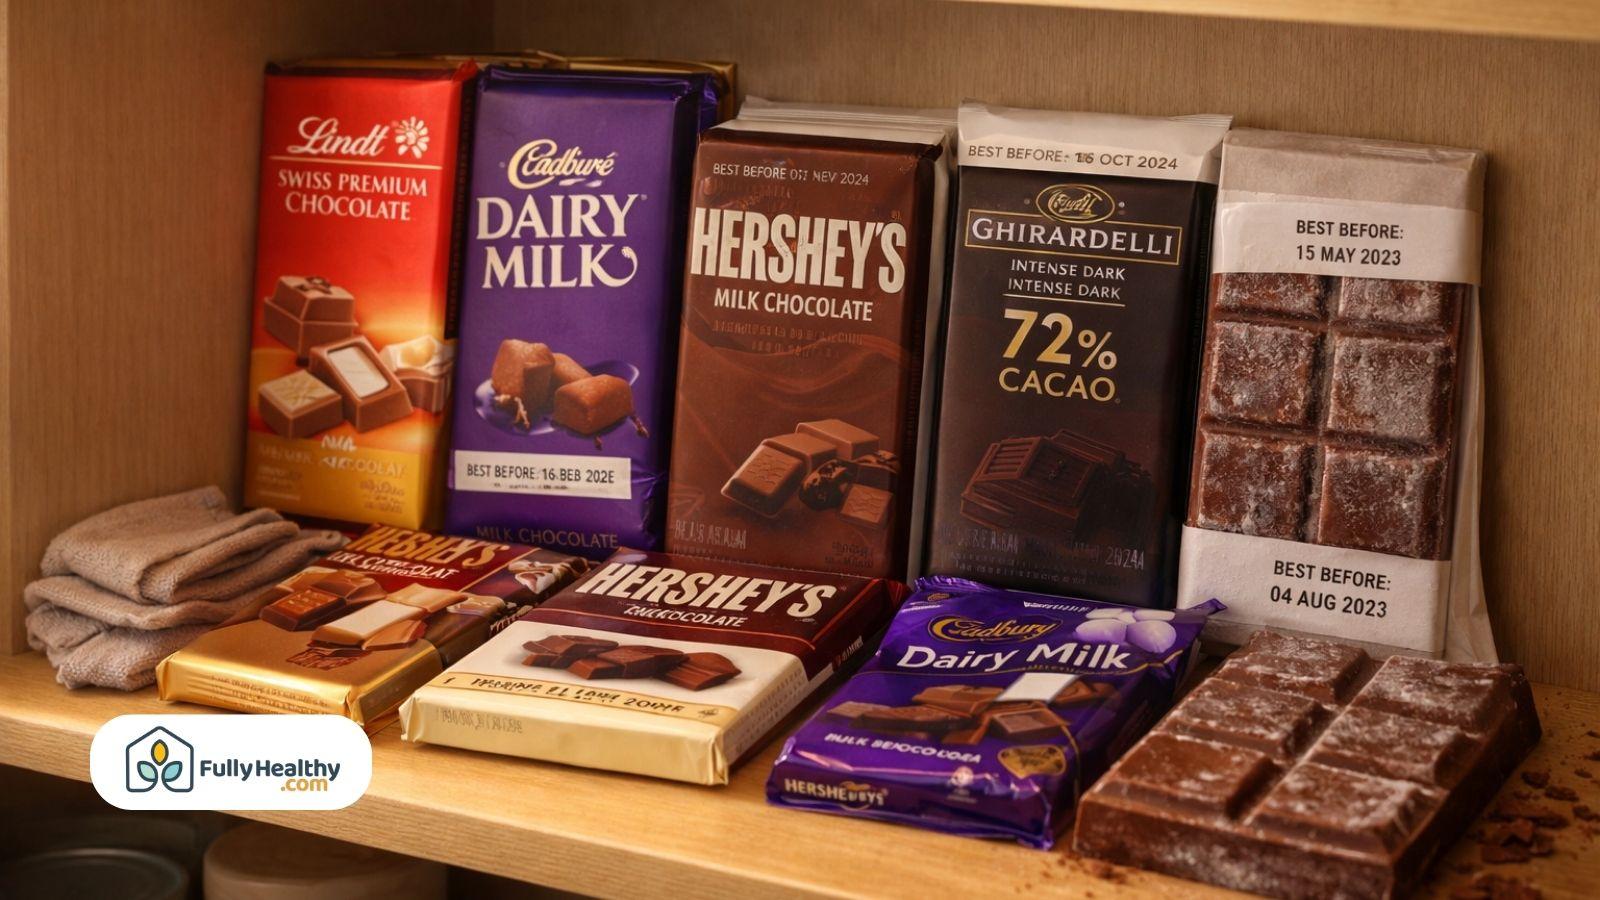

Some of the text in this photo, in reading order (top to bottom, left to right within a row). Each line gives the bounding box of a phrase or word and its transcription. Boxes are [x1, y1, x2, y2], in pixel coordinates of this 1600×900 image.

[287, 117, 390, 156] Lindt
[968, 145, 1003, 158] BEST
[1100, 153, 1133, 167] OCT
[1138, 156, 1178, 170] 2024
[278, 169, 428, 196] SWISS PREMIUM
[713, 163, 740, 176] BEST
[743, 166, 787, 180] BEFORE
[839, 172, 869, 186] 2024
[285, 192, 411, 221] CHOCOLATE
[476, 194, 639, 240] DAIRY
[972, 217, 1172, 256] GHIRARDELLI
[1296, 219, 1403, 239] BEST BEFORE:
[690, 207, 907, 294] HERSHEY'S
[1296, 245, 1401, 266] 15 MAY 2023
[482, 244, 638, 288] MILK
[1011, 259, 1126, 281] INTENSE DARK
[1008, 278, 1121, 300] INTENSE DARK
[714, 288, 873, 321] MILK CHOCOLATE
[1002, 308, 1118, 370] 72%
[999, 367, 1116, 402] CACAO
[467, 464, 491, 477] BEST
[476, 526, 619, 549] MILK CHOCOLATE
[575, 562, 837, 618] HERSHEY'S
[1274, 560, 1391, 591] BEST BEFORE:
[1270, 585, 1387, 618] 04 AUG 2023
[932, 618, 1060, 642] Cadbury
[896, 645, 1020, 672] Dairy
[1026, 642, 1132, 670] Milk
